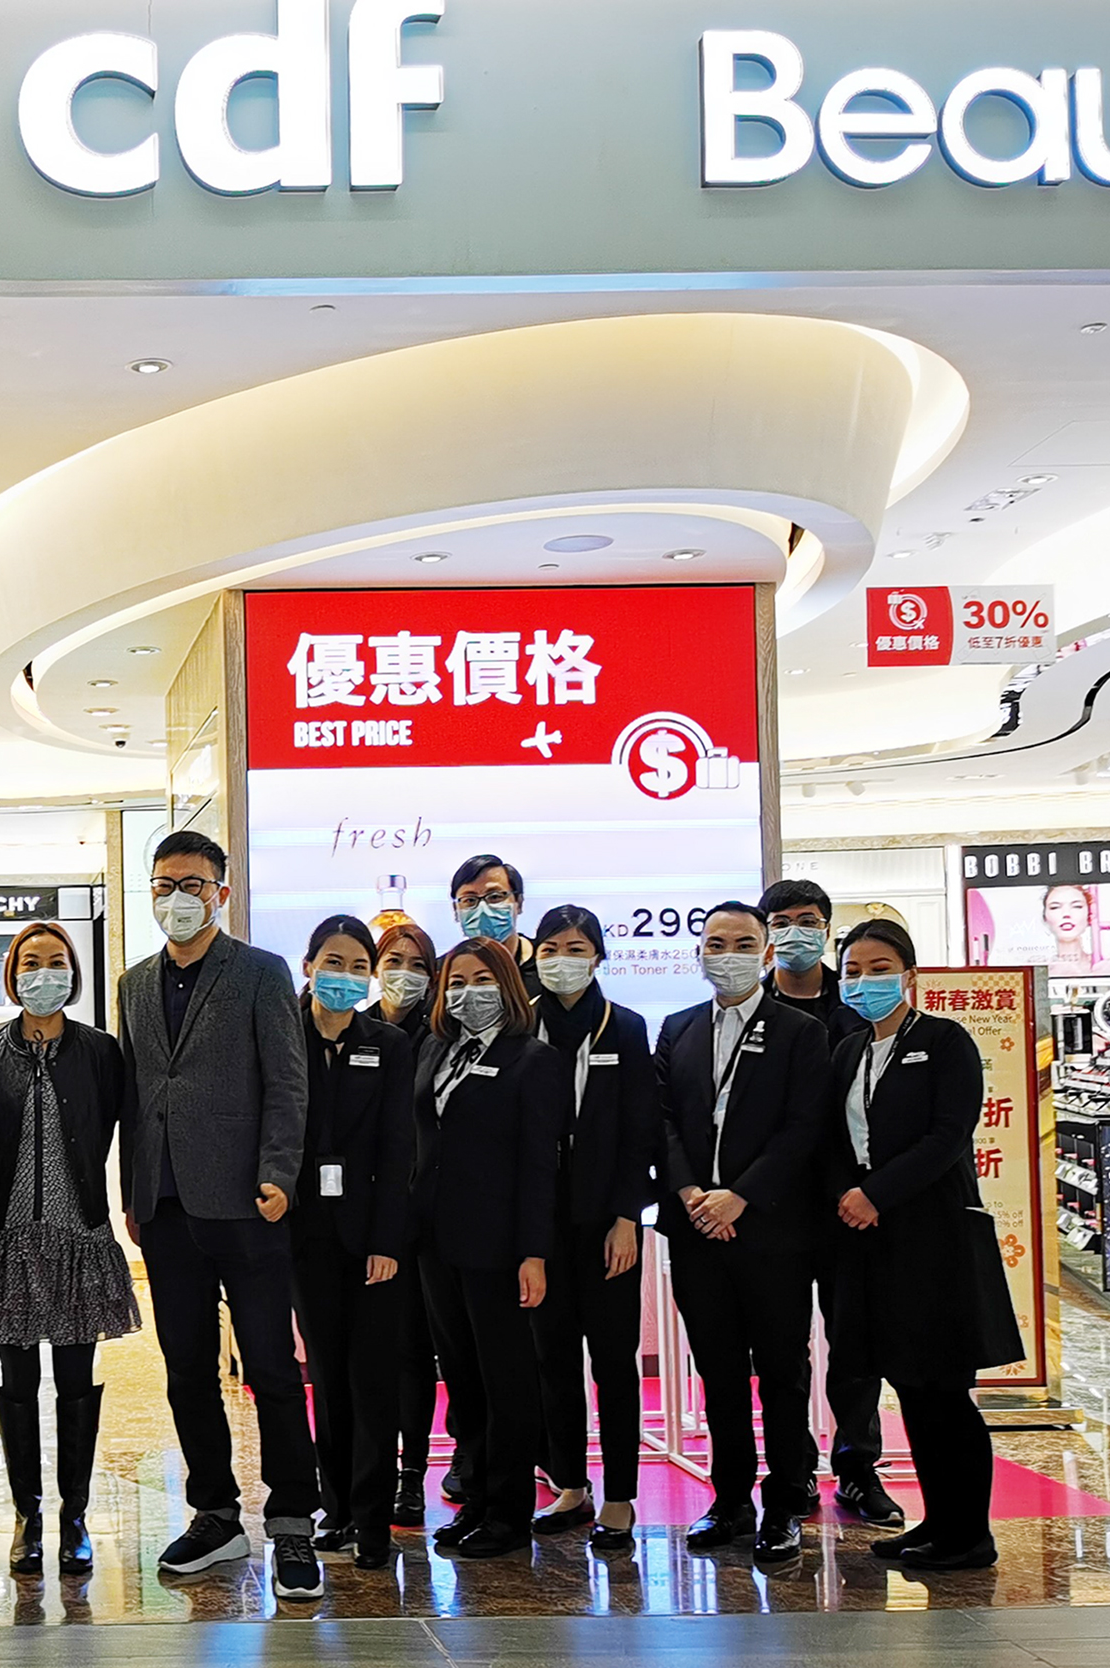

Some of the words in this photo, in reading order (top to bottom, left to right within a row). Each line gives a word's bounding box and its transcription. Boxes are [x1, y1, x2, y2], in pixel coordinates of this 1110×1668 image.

[18, 0, 445, 198] cdf
[963, 600, 1049, 629] 30%
[876, 635, 939, 652] 優惠價格
[286, 629, 603, 709] 優惠價格
[294, 720, 348, 748] BEST
[351, 720, 414, 747] PRICE
[331, 816, 432, 857] fresh
[963, 852, 1058, 878] BOBBI
[631, 963, 668, 976] Toner
[924, 988, 1017, 1012] 新春激賞
[969, 1014, 991, 1024] New
[991, 1014, 1013, 1024] Year
[977, 1026, 1002, 1036] Offer
[983, 1097, 1013, 1128] 折
